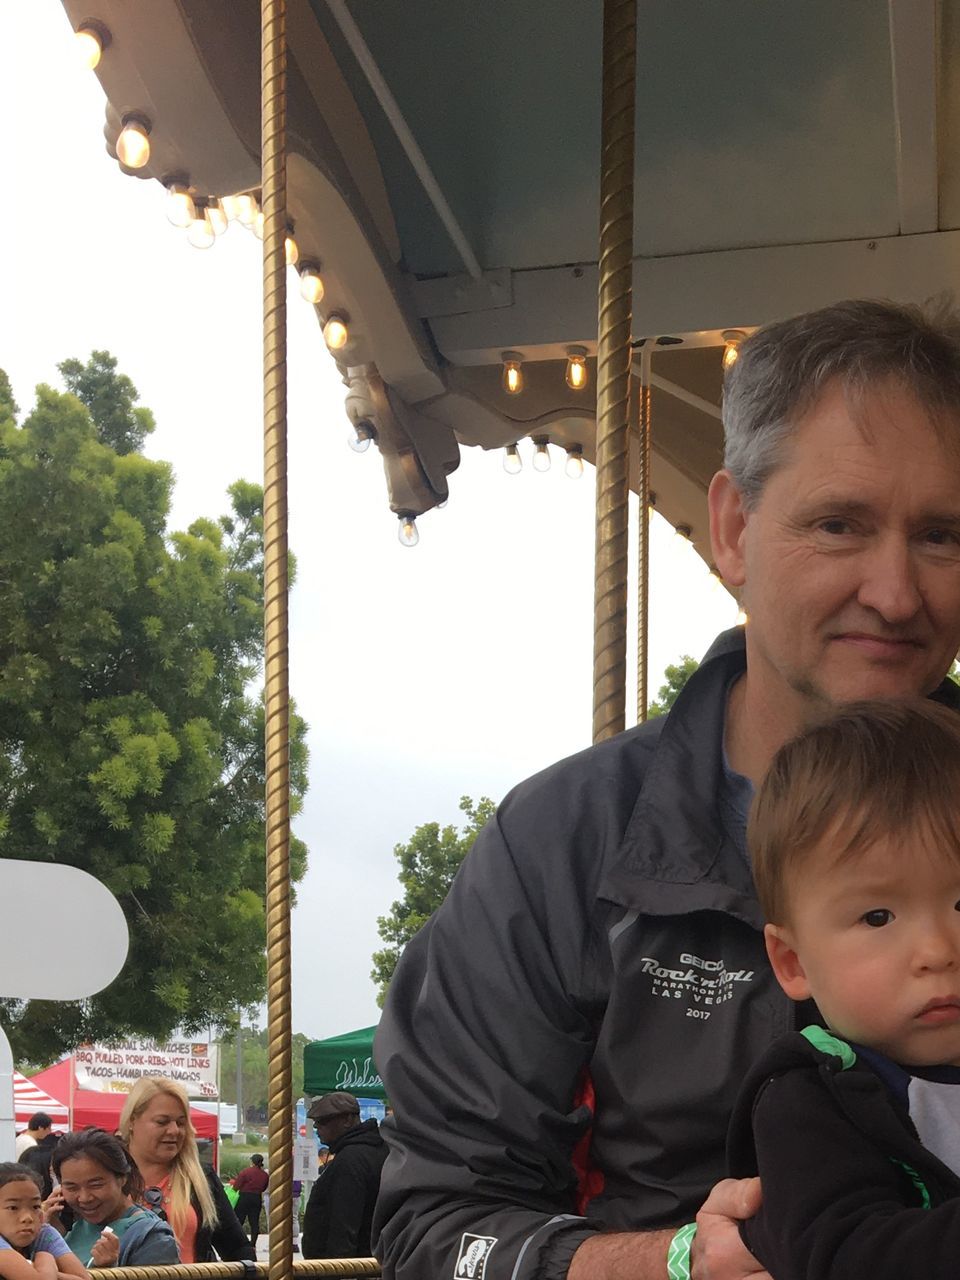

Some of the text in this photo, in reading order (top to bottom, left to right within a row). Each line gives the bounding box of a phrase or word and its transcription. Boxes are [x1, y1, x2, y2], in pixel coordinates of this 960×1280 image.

[680, 953, 725, 971] GEICO
[641, 957, 699, 984] Rock
[718, 969, 755, 987] Roll
[652, 987, 733, 1005] LAS VEGAS
[653, 979, 715, 996] MARATHON
[686, 1008, 711, 1021] 2017
[76, 1051, 93, 1064] BBQ
[95, 1052, 124, 1064] PULLED
[187, 1058, 210, 1069] LINKS
